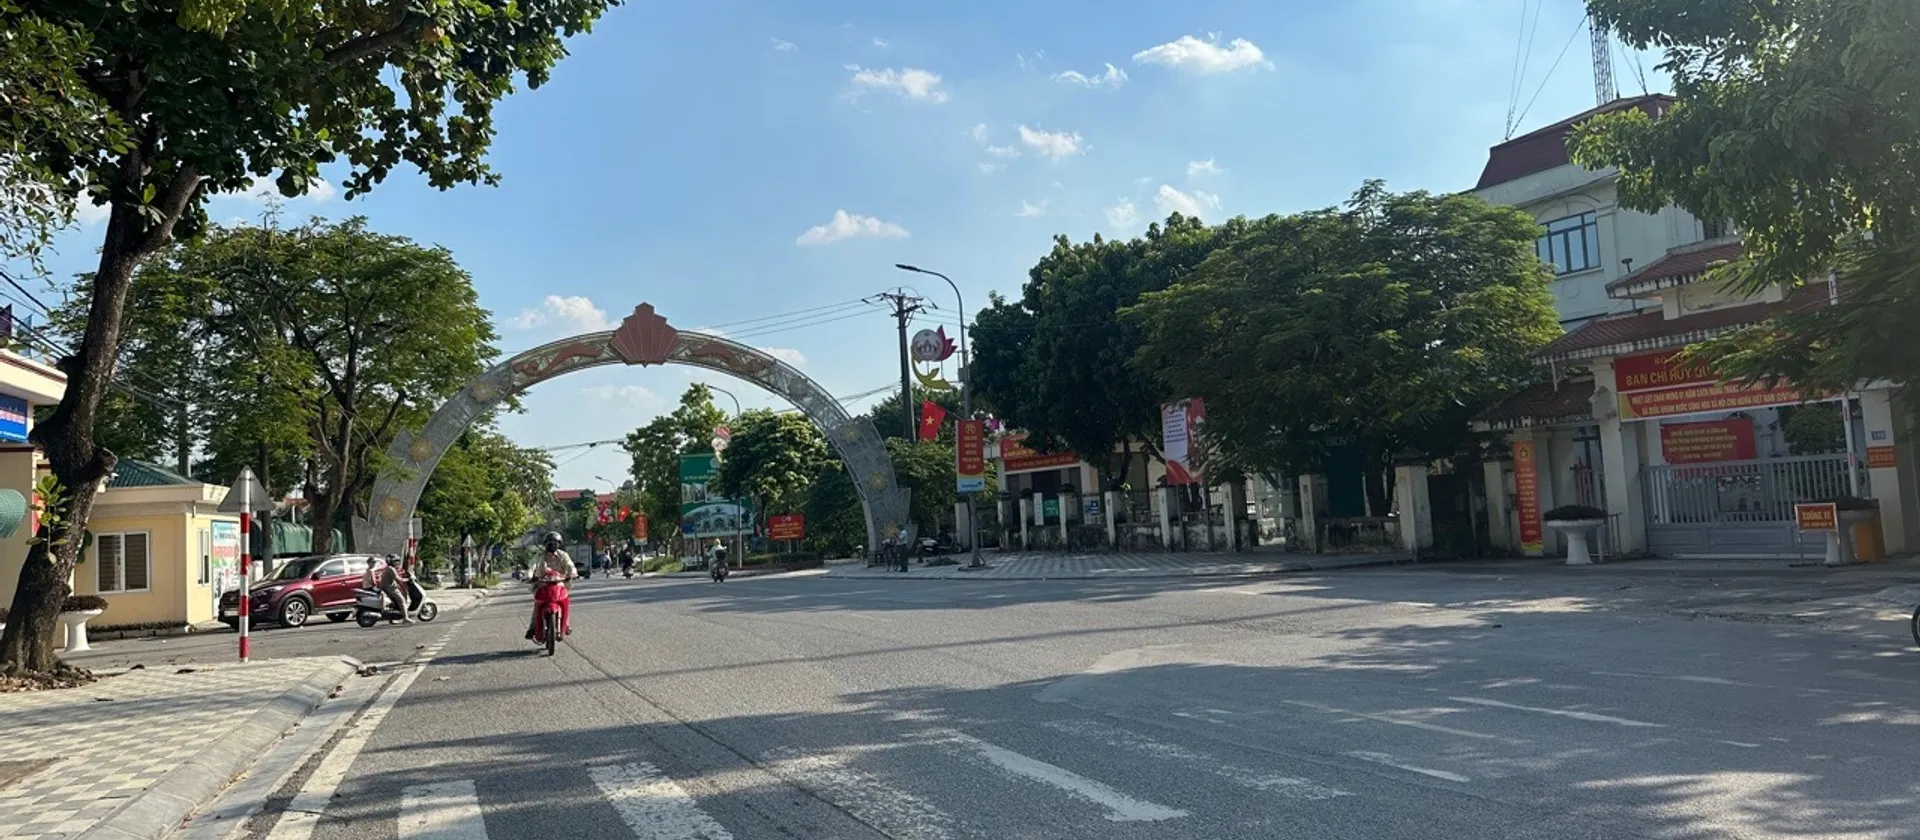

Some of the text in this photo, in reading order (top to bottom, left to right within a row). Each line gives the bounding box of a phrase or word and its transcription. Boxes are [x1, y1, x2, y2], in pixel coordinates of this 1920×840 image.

[1626, 373, 1648, 387] BAN
[1650, 367, 1668, 383] CHỈ
[1670, 367, 1693, 381] HUY
